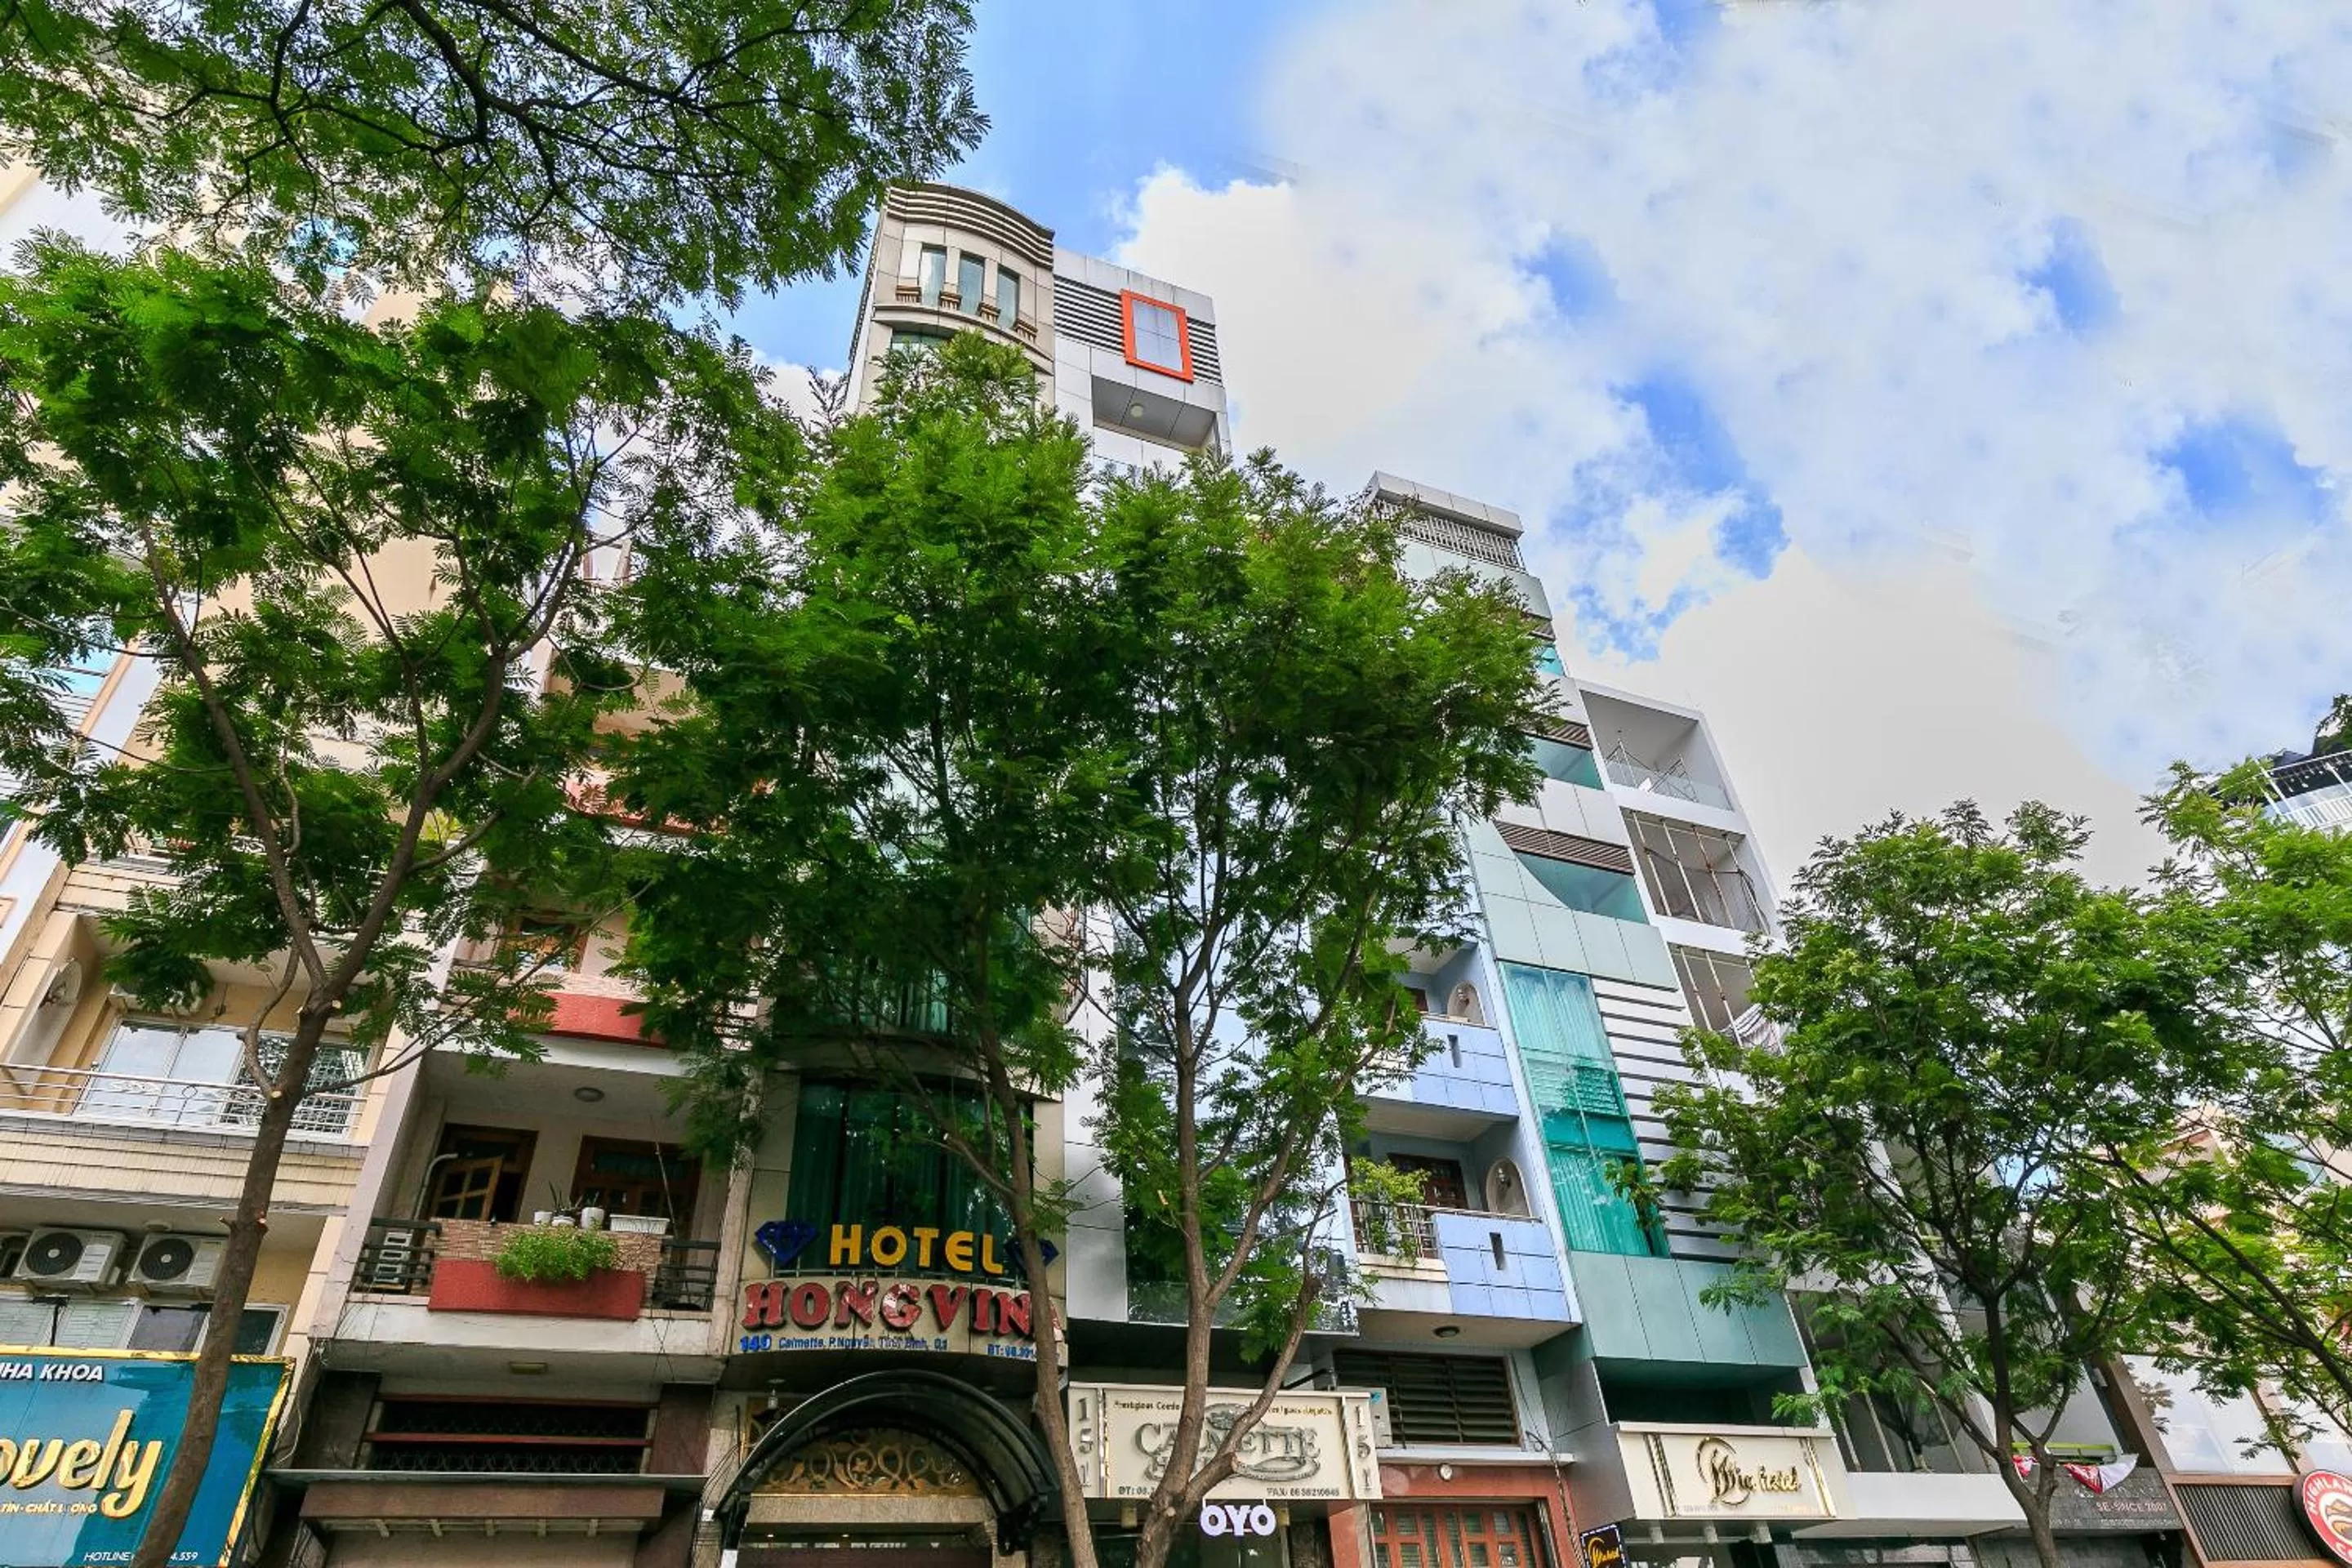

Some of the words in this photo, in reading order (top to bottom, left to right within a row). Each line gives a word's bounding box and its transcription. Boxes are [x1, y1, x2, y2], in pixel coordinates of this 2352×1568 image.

[828, 1223, 1004, 1275] HOTEL
[741, 1280, 1062, 1335] HONGVIN
[39, 1364, 104, 1382] KHOA
[1200, 1504, 1277, 1536] OYO
